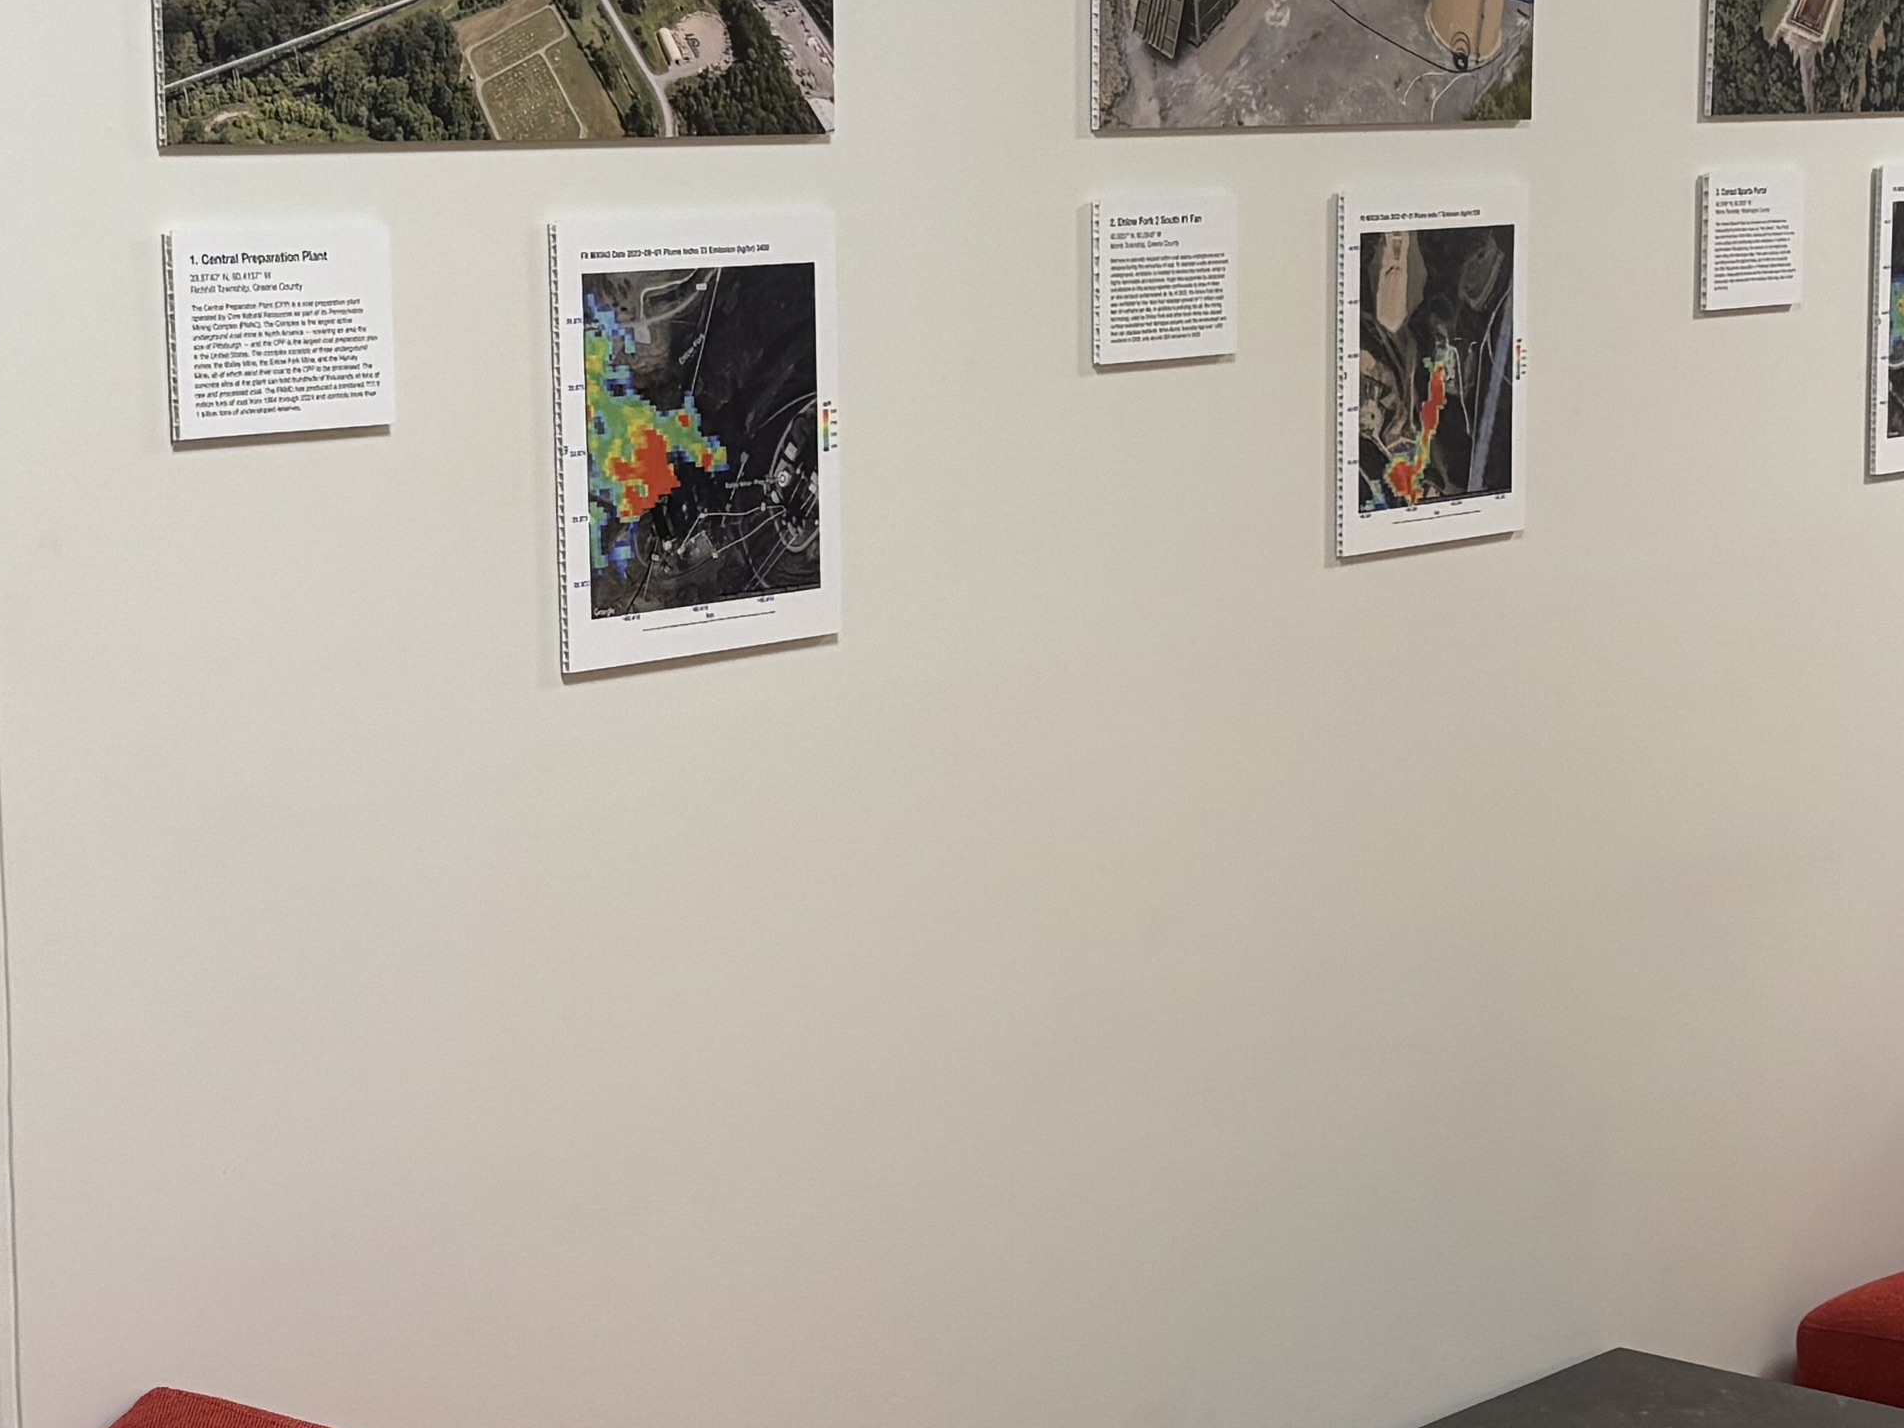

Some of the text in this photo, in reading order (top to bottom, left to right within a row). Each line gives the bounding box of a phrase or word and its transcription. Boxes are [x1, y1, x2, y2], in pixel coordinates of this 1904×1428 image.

[189, 250, 328, 267] 1. Central Preparation Plant
